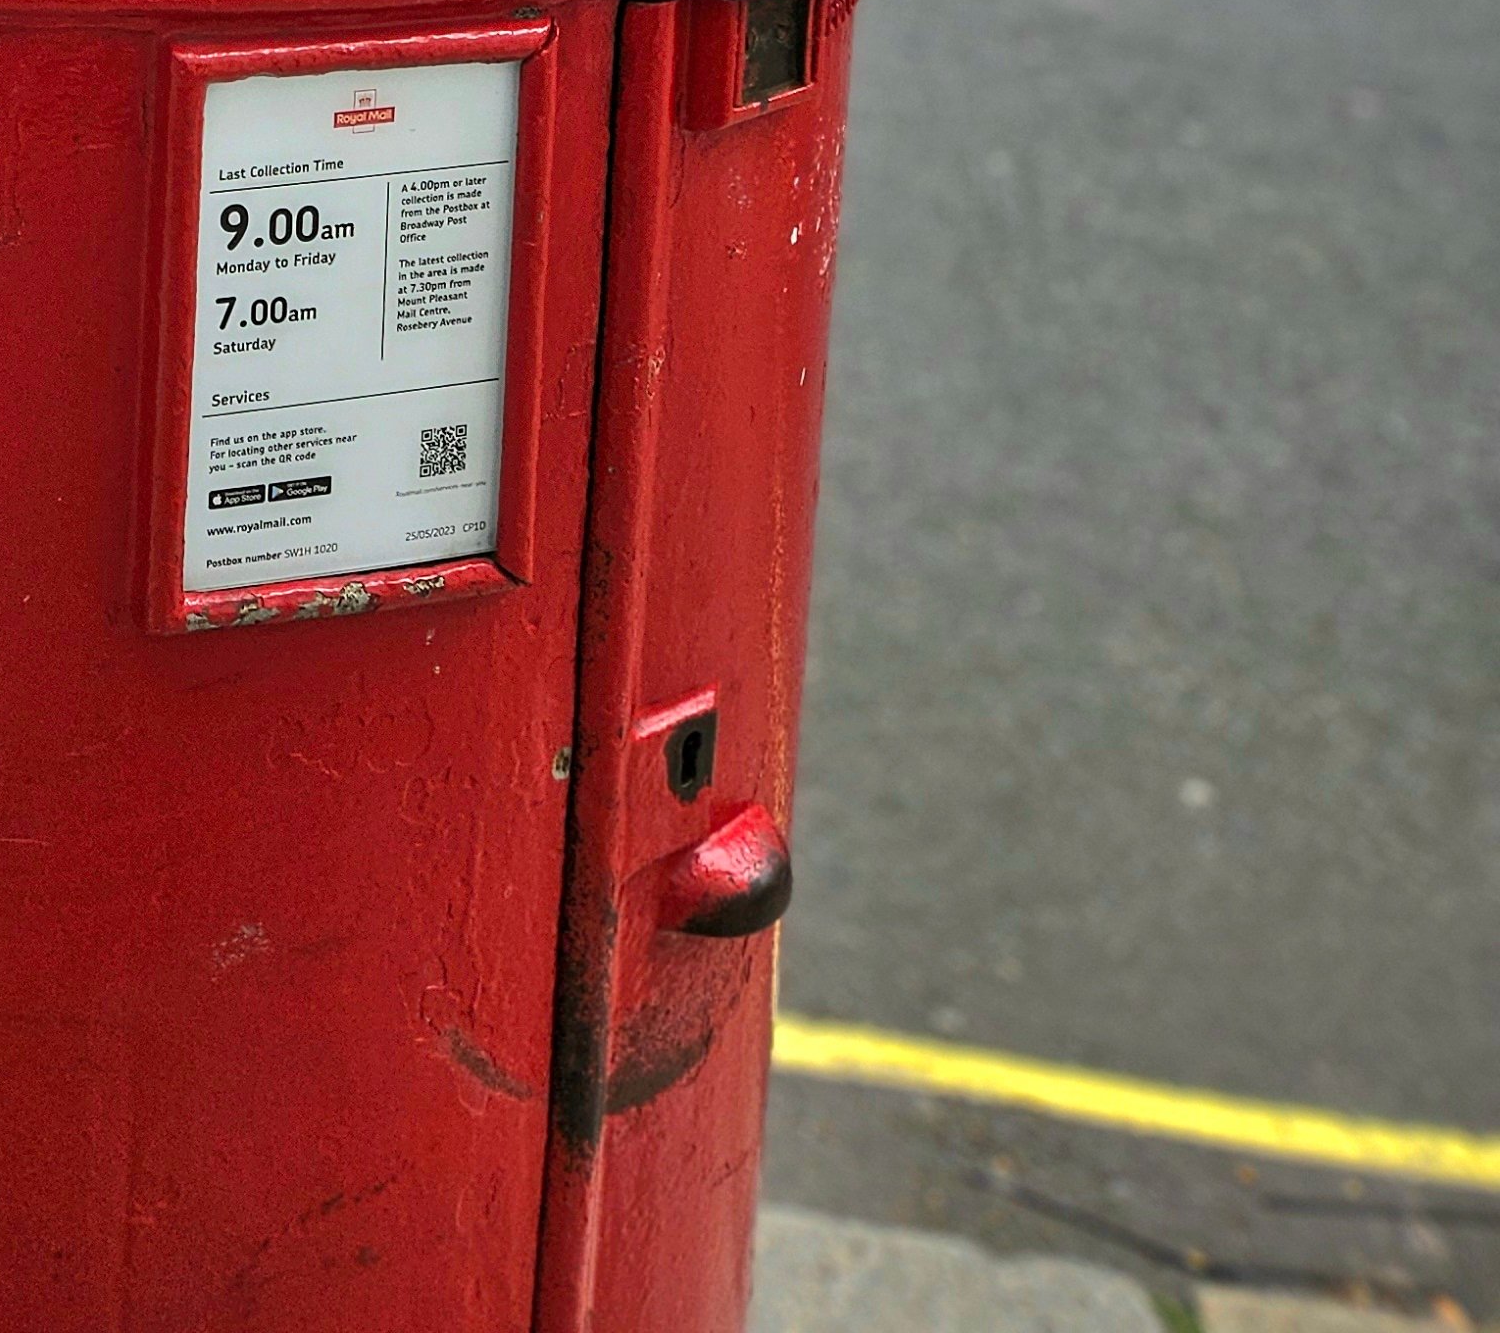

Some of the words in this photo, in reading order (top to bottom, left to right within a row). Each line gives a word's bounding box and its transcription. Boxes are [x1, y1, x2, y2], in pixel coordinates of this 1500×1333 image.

[337, 112, 367, 125] Royal
[368, 109, 392, 121] Mail
[219, 168, 246, 181] Last
[250, 162, 309, 178] Collection
[313, 159, 344, 171] Time
[401, 184, 408, 193] A
[410, 180, 450, 191] 4.00pm
[465, 177, 487, 186] later
[401, 194, 444, 206] collection
[447, 191, 454, 200] is
[457, 189, 482, 199] made
[401, 209, 422, 218] from
[425, 207, 440, 215] the
[443, 203, 478, 214] Postbox
[481, 201, 490, 209] at
[220, 204, 355, 251] 9.00am
[400, 220, 444, 231] Broadway
[447, 216, 467, 226] Post
[400, 233, 426, 243] Office
[216, 259, 270, 275] Monday
[275, 257, 288, 269] to
[294, 252, 336, 267] Friday
[399, 259, 416, 268] The
[418, 255, 444, 266] latest
[446, 251, 489, 263] collection
[398, 272, 407, 281] in
[410, 270, 425, 280] the
[427, 269, 447, 277] area
[450, 266, 458, 275] is
[460, 263, 485, 273] made
[398, 286, 407, 294] at
[410, 282, 446, 293] 7.30pm
[449, 279, 471, 288] from
[398, 296, 426, 307] Mount
[429, 291, 468, 303] Pleasant
[215, 296, 317, 330] 7.00am
[397, 309, 416, 320] Mail
[419, 307, 451, 317] Centre,
[396, 321, 438, 332] Rosebery
[439, 316, 472, 327] Avenue
[213, 337, 276, 355] Saturday
[212, 390, 270, 407] Services
[210, 436, 230, 447] Find
[233, 436, 244, 444] us
[262, 432, 277, 441] the
[280, 430, 297, 439] app
[300, 427, 326, 436] store.
[210, 450, 226, 460] For
[228, 446, 265, 458] locating
[268, 442, 293, 452] other
[296, 438, 333, 449] services
[336, 434, 357, 443] near
[209, 464, 226, 474] you
[236, 460, 257, 469] scan
[261, 457, 276, 466] the
[279, 453, 292, 463] QR
[295, 451, 316, 461] code
[224, 497, 239, 505] App
[241, 494, 261, 502] Store
[286, 486, 312, 496] Google
[207, 516, 312, 536] www.royalmail.com
[405, 525, 455, 541] 25/05/2023
[206, 557, 242, 568] Postbox
[245, 552, 282, 563] number
[284, 547, 311, 558] SW1H
[315, 543, 338, 554] 1020
